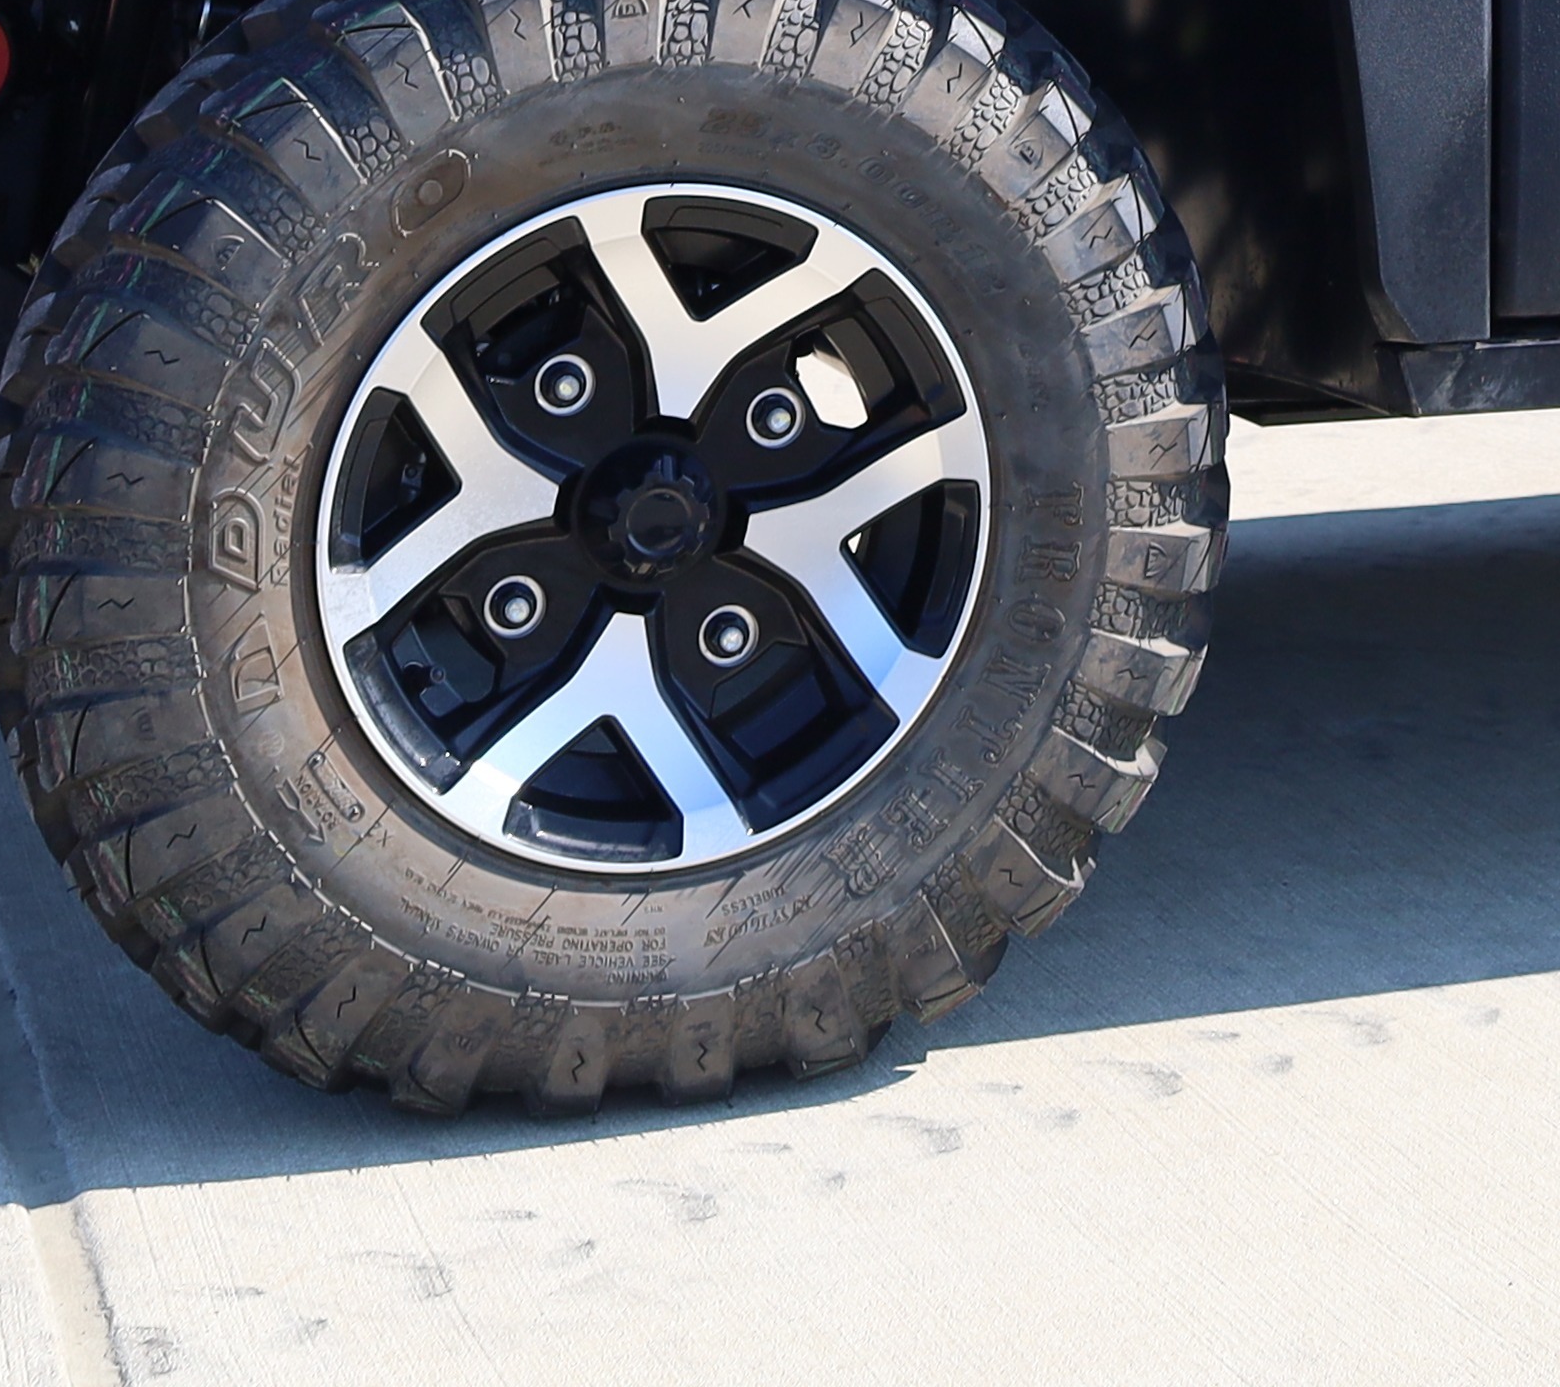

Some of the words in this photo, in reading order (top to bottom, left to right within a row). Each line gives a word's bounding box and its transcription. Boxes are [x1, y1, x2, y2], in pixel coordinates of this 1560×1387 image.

[208, 148, 472, 592] DURO
[269, 454, 303, 588] Radial
[821, 480, 1085, 901] FRONTIER
[721, 884, 788, 917] TUBELESS
[489, 922, 555, 948] PRESSURE
[562, 937, 635, 953] OPERATING
[641, 938, 667, 952] FOR
[532, 948, 572, 967] LABEL
[580, 952, 635, 968] VEHICLE
